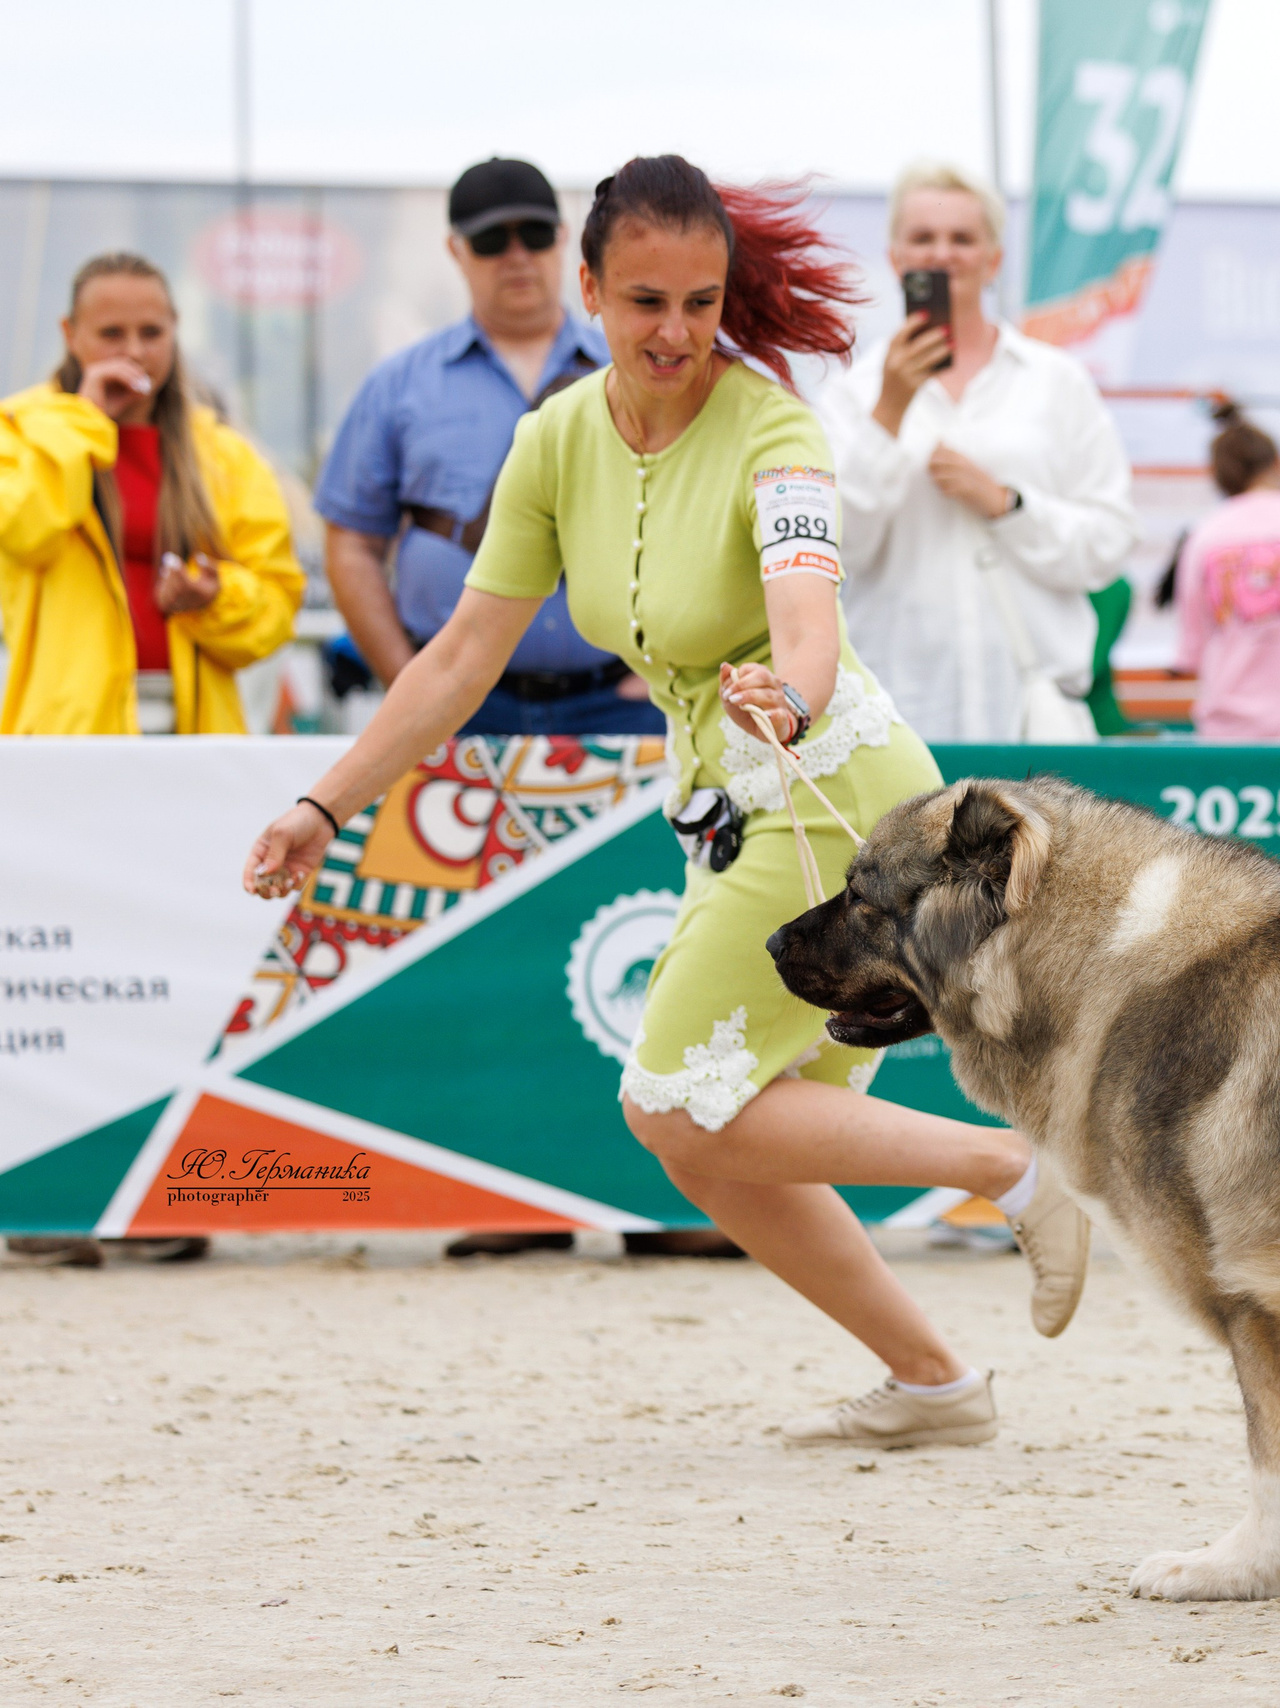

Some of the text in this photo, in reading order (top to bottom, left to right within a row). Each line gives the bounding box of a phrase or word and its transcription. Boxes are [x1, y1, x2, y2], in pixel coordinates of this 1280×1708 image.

[1065, 60, 1186, 234] 32
[774, 514, 828, 541] 989
[0, 976, 169, 1002] ическая
